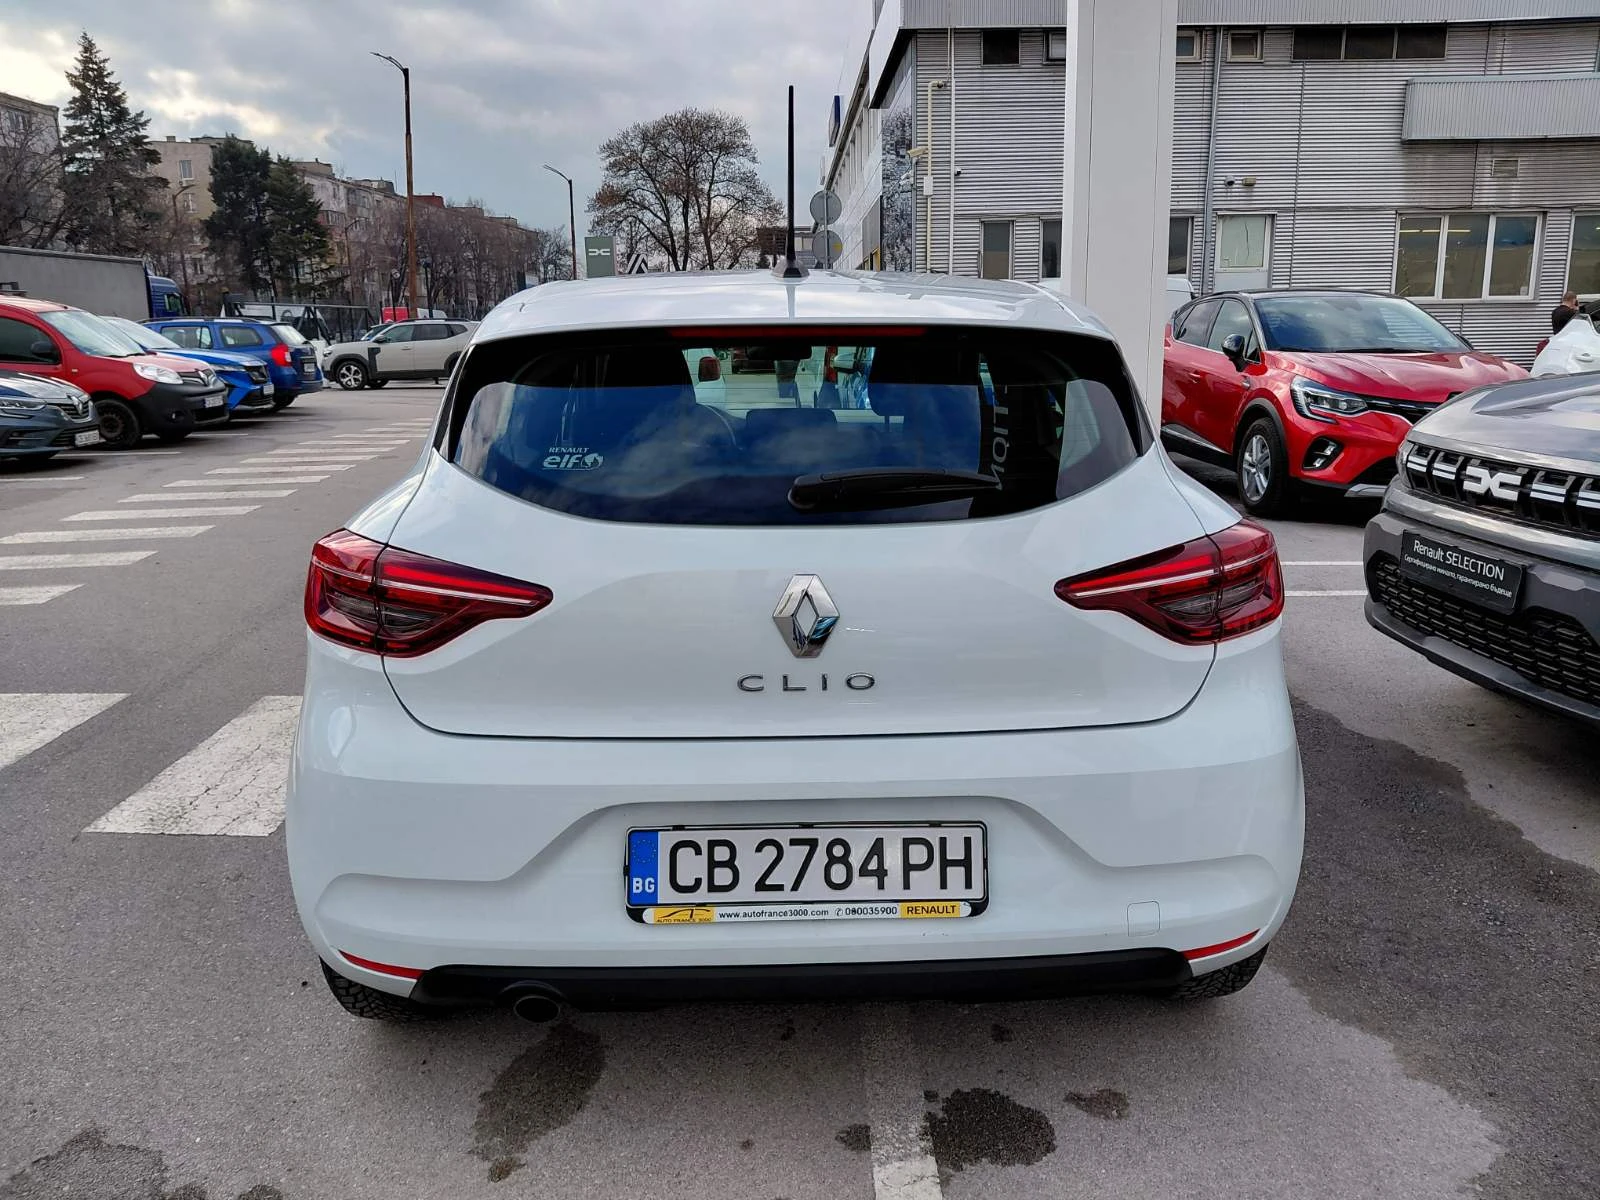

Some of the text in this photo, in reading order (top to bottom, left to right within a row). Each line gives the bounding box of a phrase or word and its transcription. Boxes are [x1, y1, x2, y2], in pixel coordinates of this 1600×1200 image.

[543, 454, 583, 468] elf
[1413, 539, 1505, 581] Renault SELECTION
[737, 673, 876, 693] CLIO
[668, 836, 973, 893] CB 2784 PH
[632, 877, 656, 893] BG
[718, 908, 829, 919] www.autofrance3000.com
[906, 904, 957, 915] RENAULT
